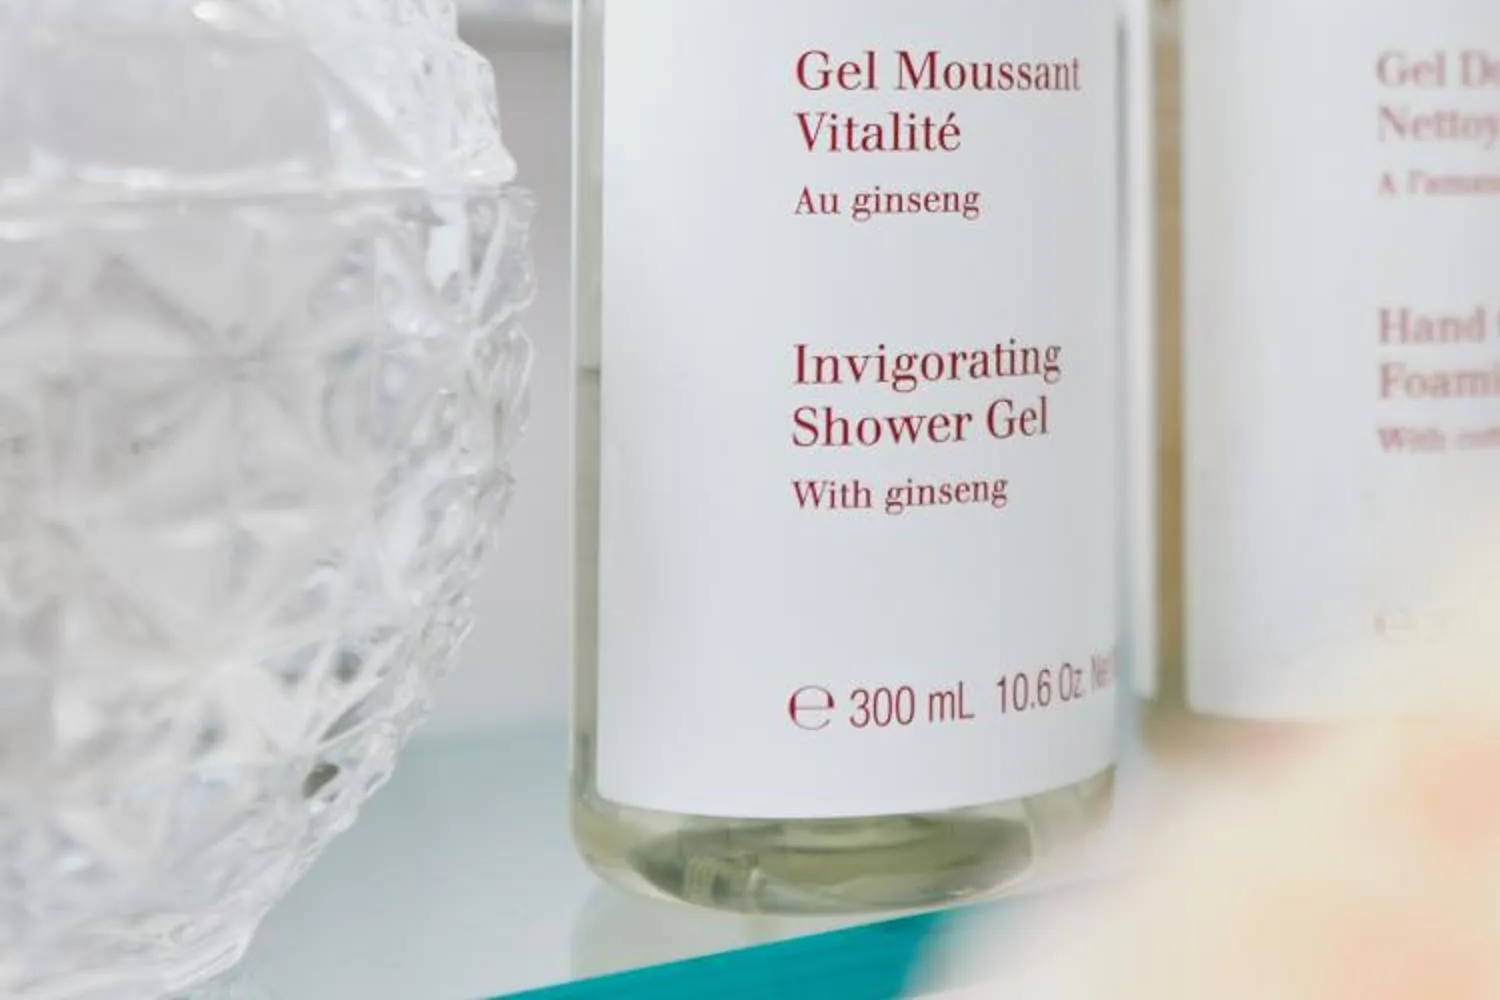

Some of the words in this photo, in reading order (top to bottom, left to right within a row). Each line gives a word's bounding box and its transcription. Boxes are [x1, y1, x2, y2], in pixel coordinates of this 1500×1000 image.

[795, 50, 878, 91] Gel
[895, 50, 1081, 92] Moussant
[1374, 49, 1447, 90] Gel
[795, 111, 961, 153] Vitalité
[795, 186, 841, 215] Au
[850, 186, 981, 223] ginseng
[1377, 304, 1487, 346] Hand
[794, 337, 1062, 393] Invigorating
[792, 405, 974, 448] Shower
[985, 395, 1049, 440] Gel
[792, 479, 873, 510] With
[884, 478, 1009, 516] ginseng
[849, 685, 916, 729] 300
[928, 680, 976, 723] mL
[996, 664, 1052, 715] 10.6
